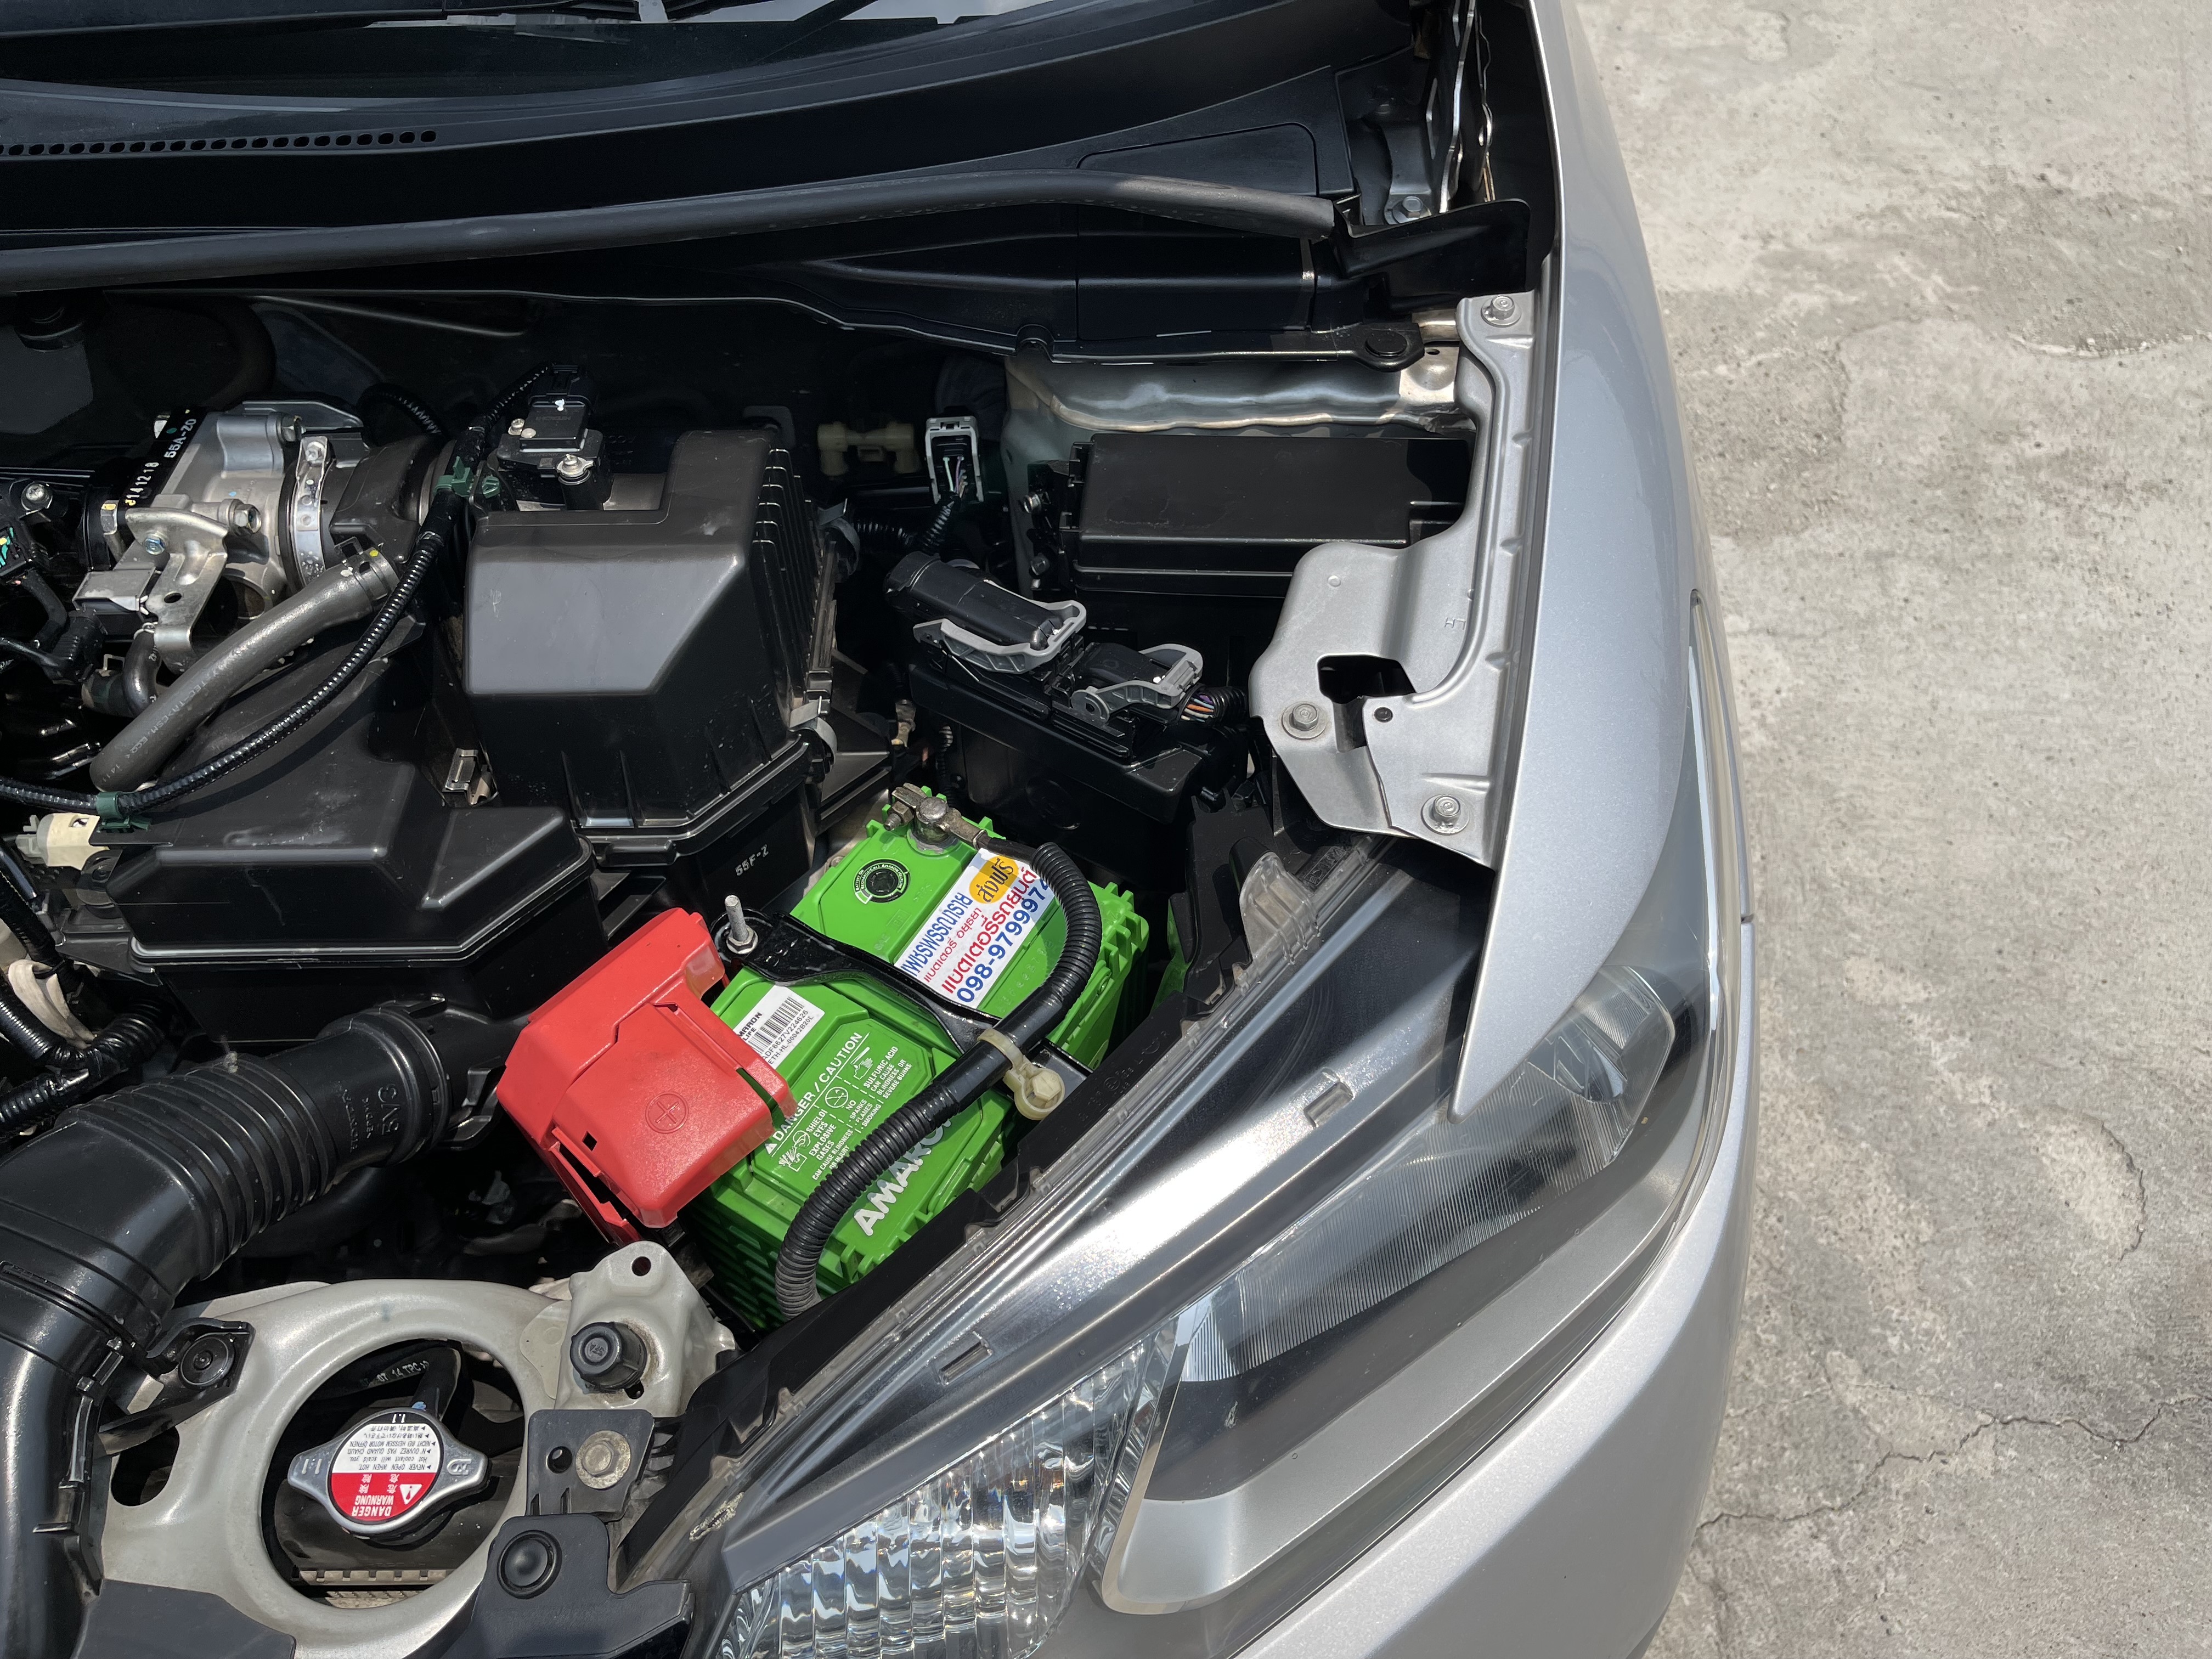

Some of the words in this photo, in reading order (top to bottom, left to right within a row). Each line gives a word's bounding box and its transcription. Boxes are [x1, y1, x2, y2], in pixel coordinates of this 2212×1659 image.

[976, 857, 1013, 902] ส่งฟรี
[902, 893, 973, 975] เพชรพรรณาราย
[942, 868, 1036, 993] แบตเตอรี่รถยนต์
[924, 939, 957, 982] แบตเตอรี่
[956, 907, 983, 938] อยุธยา
[736, 1012, 762, 1038] MARON
[742, 1027, 756, 1041] LIFE
[862, 1059, 889, 1089] SULFURIC
[884, 1045, 899, 1062] ACID
[870, 1079, 882, 1092] CAN
[878, 1062, 895, 1081] CAUSE
[875, 1067, 900, 1096] BLINDNESS
[897, 1058, 906, 1068] OR
[772, 1092, 814, 1141] DANGER
[819, 1032, 862, 1083] CAUTION
[882, 1079, 900, 1099] SEVERE
[895, 1062, 913, 1081] BURNS
[845, 1098, 857, 1111] NO
[849, 1098, 868, 1120] SPARKS
[854, 1102, 873, 1124] FLAMES
[860, 1102, 883, 1127] SMOKING
[805, 1110, 827, 1134] SHIELD
[812, 1120, 829, 1138] EYES
[808, 1122, 838, 1157] EXPLOSIVE
[815, 1138, 835, 1161] GASES
[811, 1167, 823, 1181] CAN
[819, 1153, 835, 1170] CAUSE
[830, 1128, 854, 1155] BLINDNESS
[833, 1144, 850, 1163] INJURY
[853, 1118, 952, 1235] AMAR
[391, 1412, 407, 1423] 1.1
[351, 1505, 392, 1516] DANGER
[354, 1494, 394, 1505] WARNUNG
